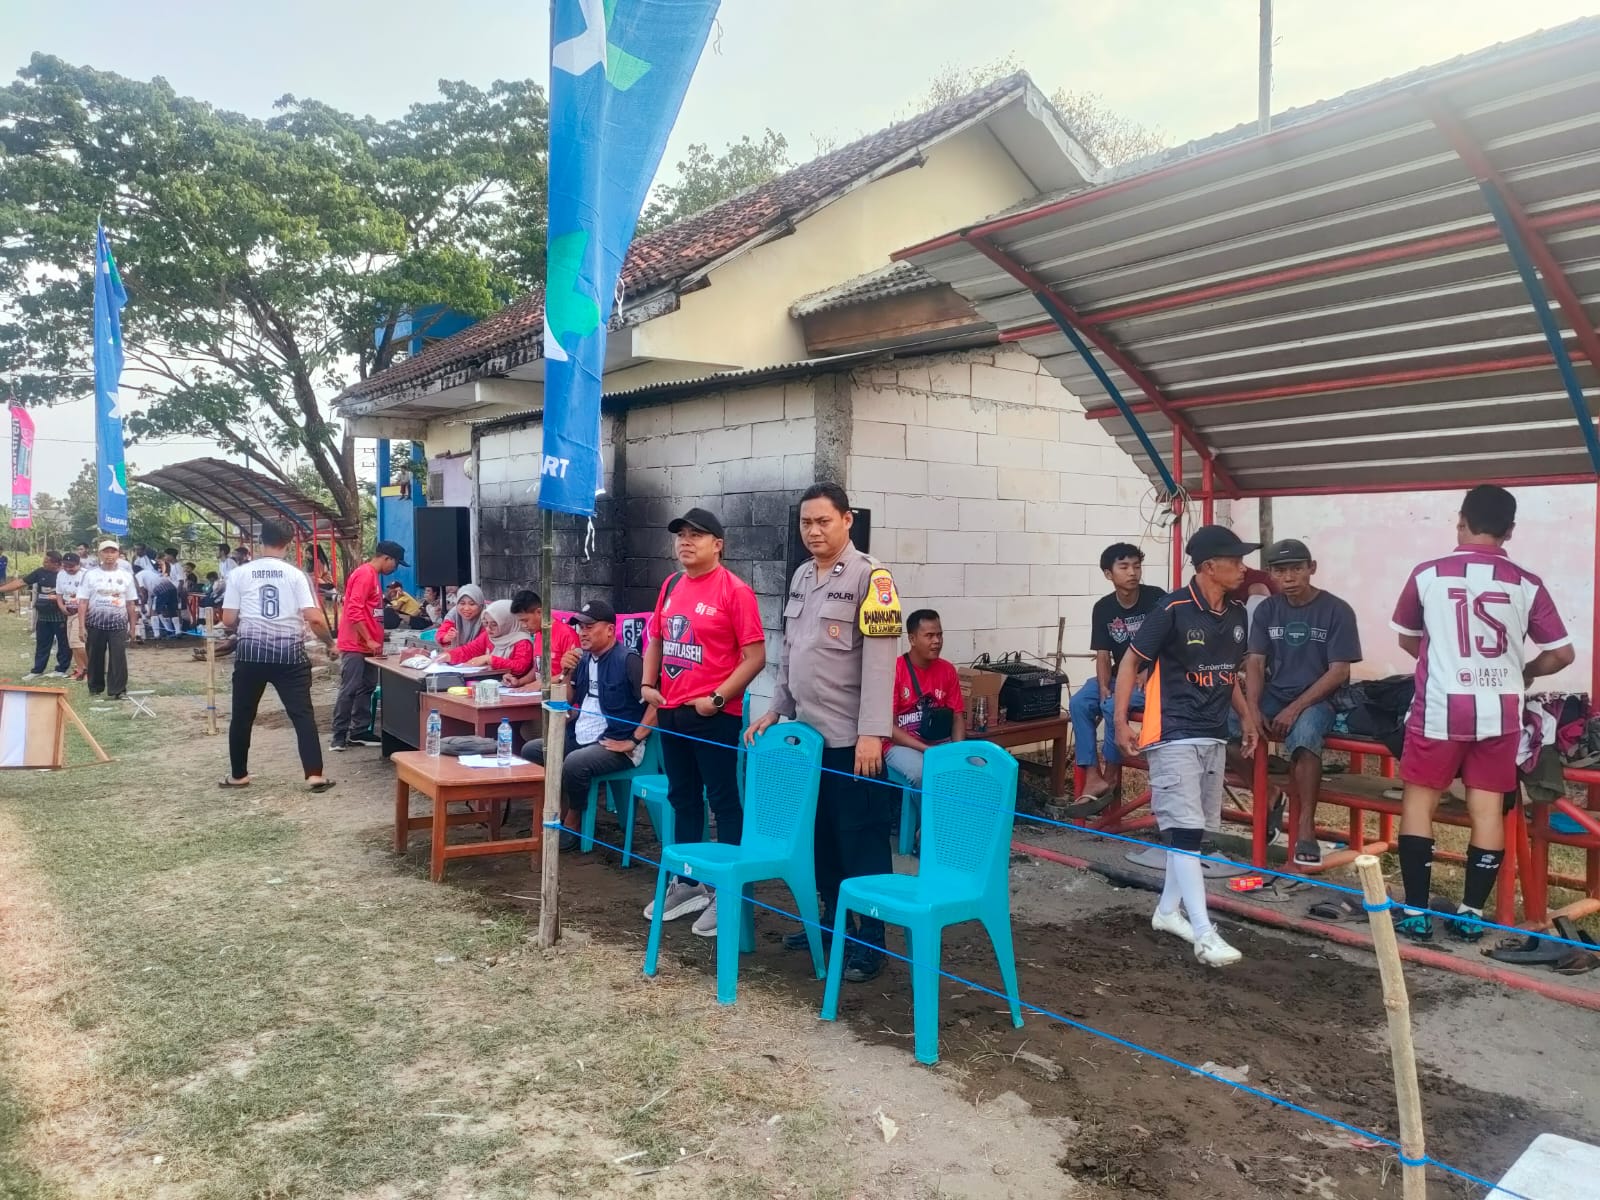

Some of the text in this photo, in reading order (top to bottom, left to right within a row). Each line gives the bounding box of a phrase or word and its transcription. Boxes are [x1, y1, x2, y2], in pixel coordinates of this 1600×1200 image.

[259, 584, 280, 619] 8
[827, 592, 854, 601] POLRI
[1447, 588, 1511, 658] 15
[1186, 671, 1213, 687] Old
